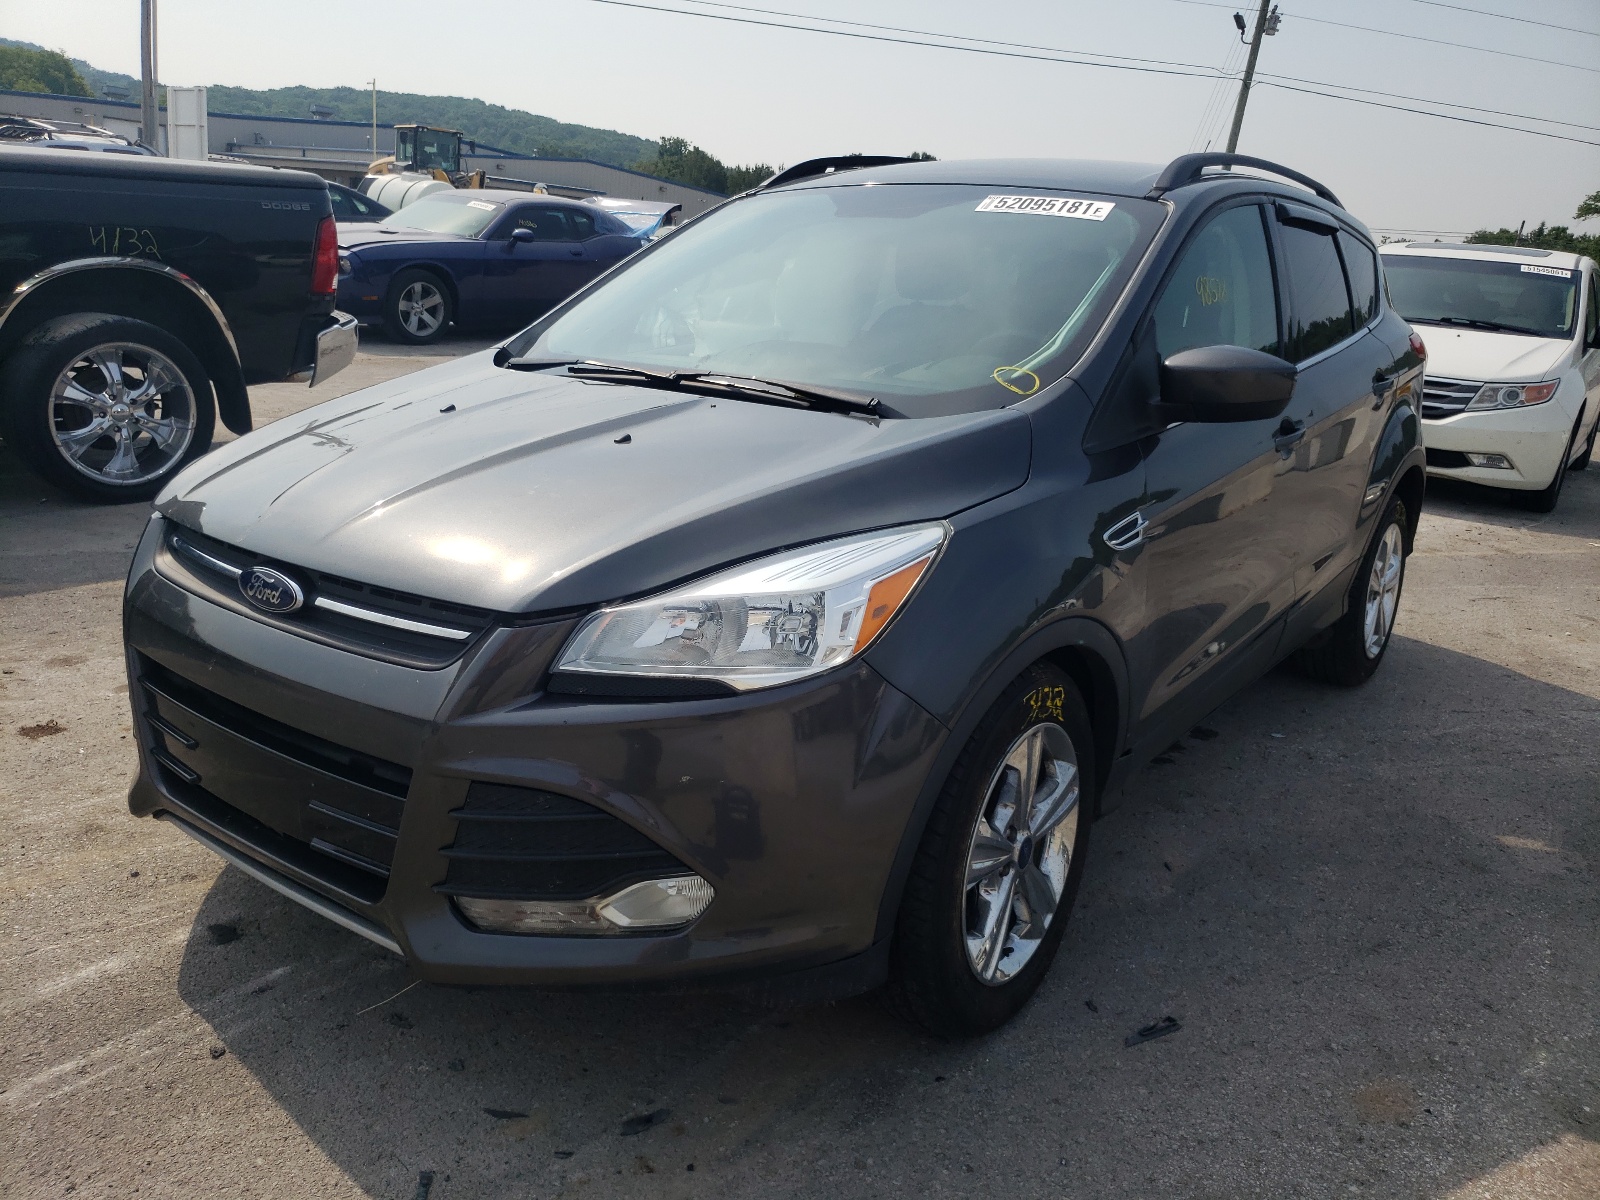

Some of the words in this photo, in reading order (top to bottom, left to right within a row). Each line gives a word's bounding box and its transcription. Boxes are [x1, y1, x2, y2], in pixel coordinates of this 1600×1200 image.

[261, 202, 311, 211] DODGE
[994, 196, 1094, 215] 52095181
[247, 572, 283, 604] Ford
